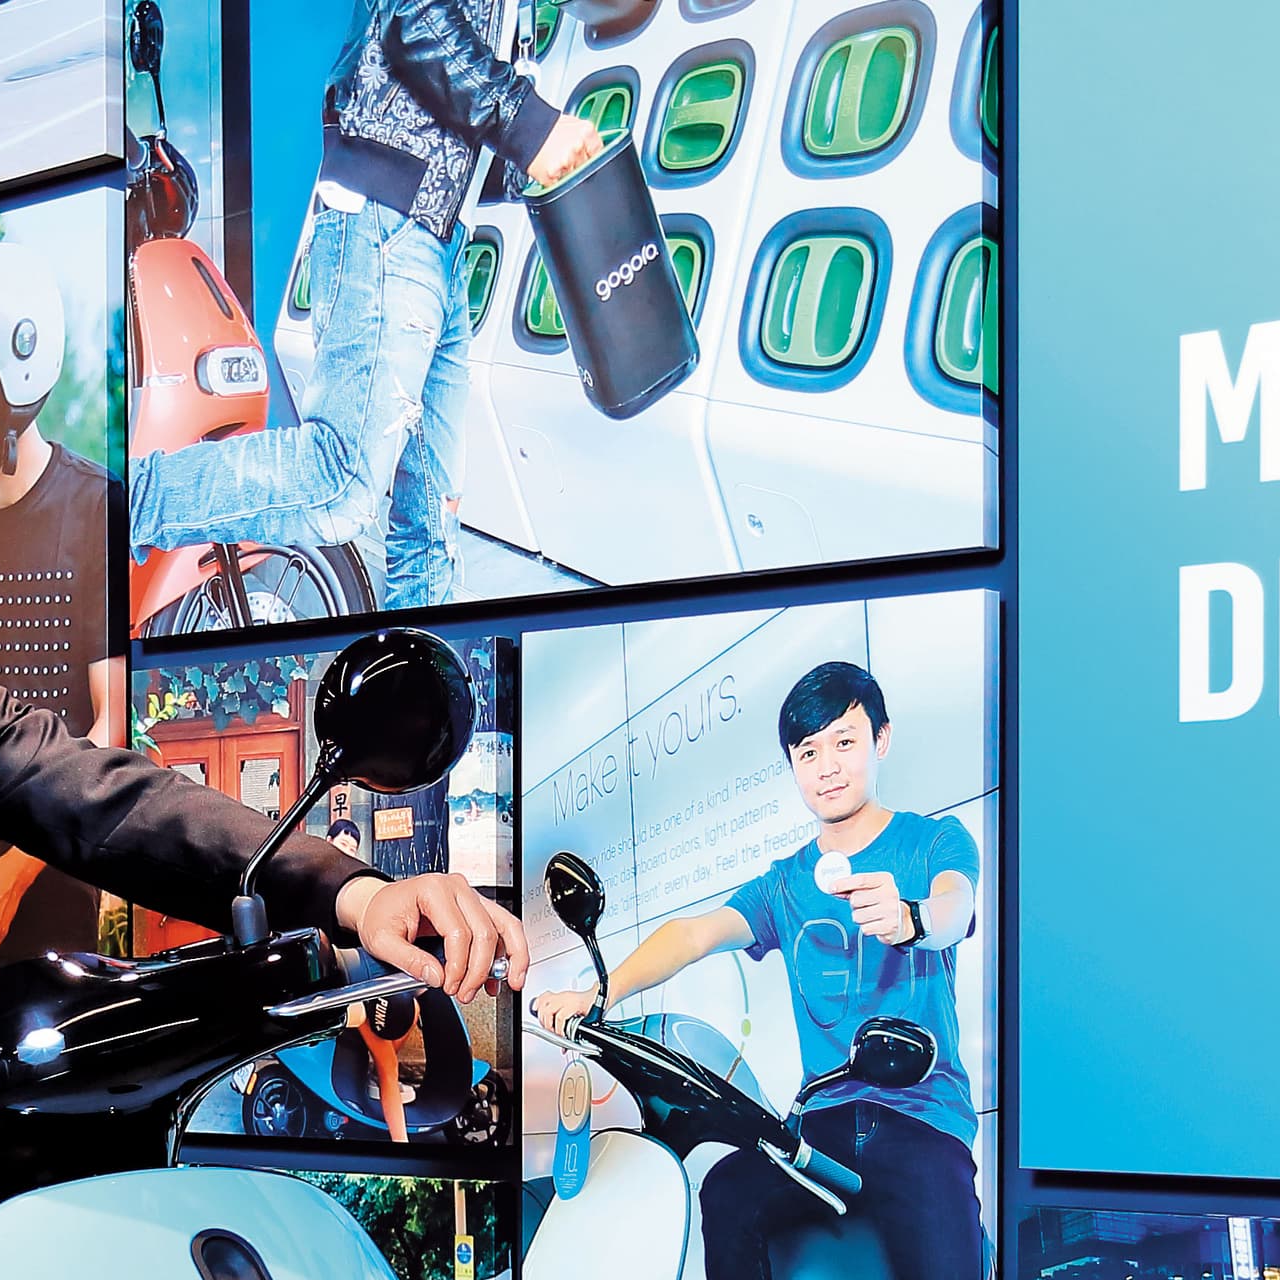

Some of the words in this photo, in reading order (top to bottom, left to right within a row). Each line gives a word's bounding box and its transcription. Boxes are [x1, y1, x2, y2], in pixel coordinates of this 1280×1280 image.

[552, 752, 618, 827] Make
[625, 731, 641, 782] it
[646, 674, 742, 781] yours.
[650, 822, 662, 838] be
[664, 811, 681, 832] one
[685, 799, 695, 822] of
[730, 799, 780, 838] patterns
[742, 842, 762, 864] the
